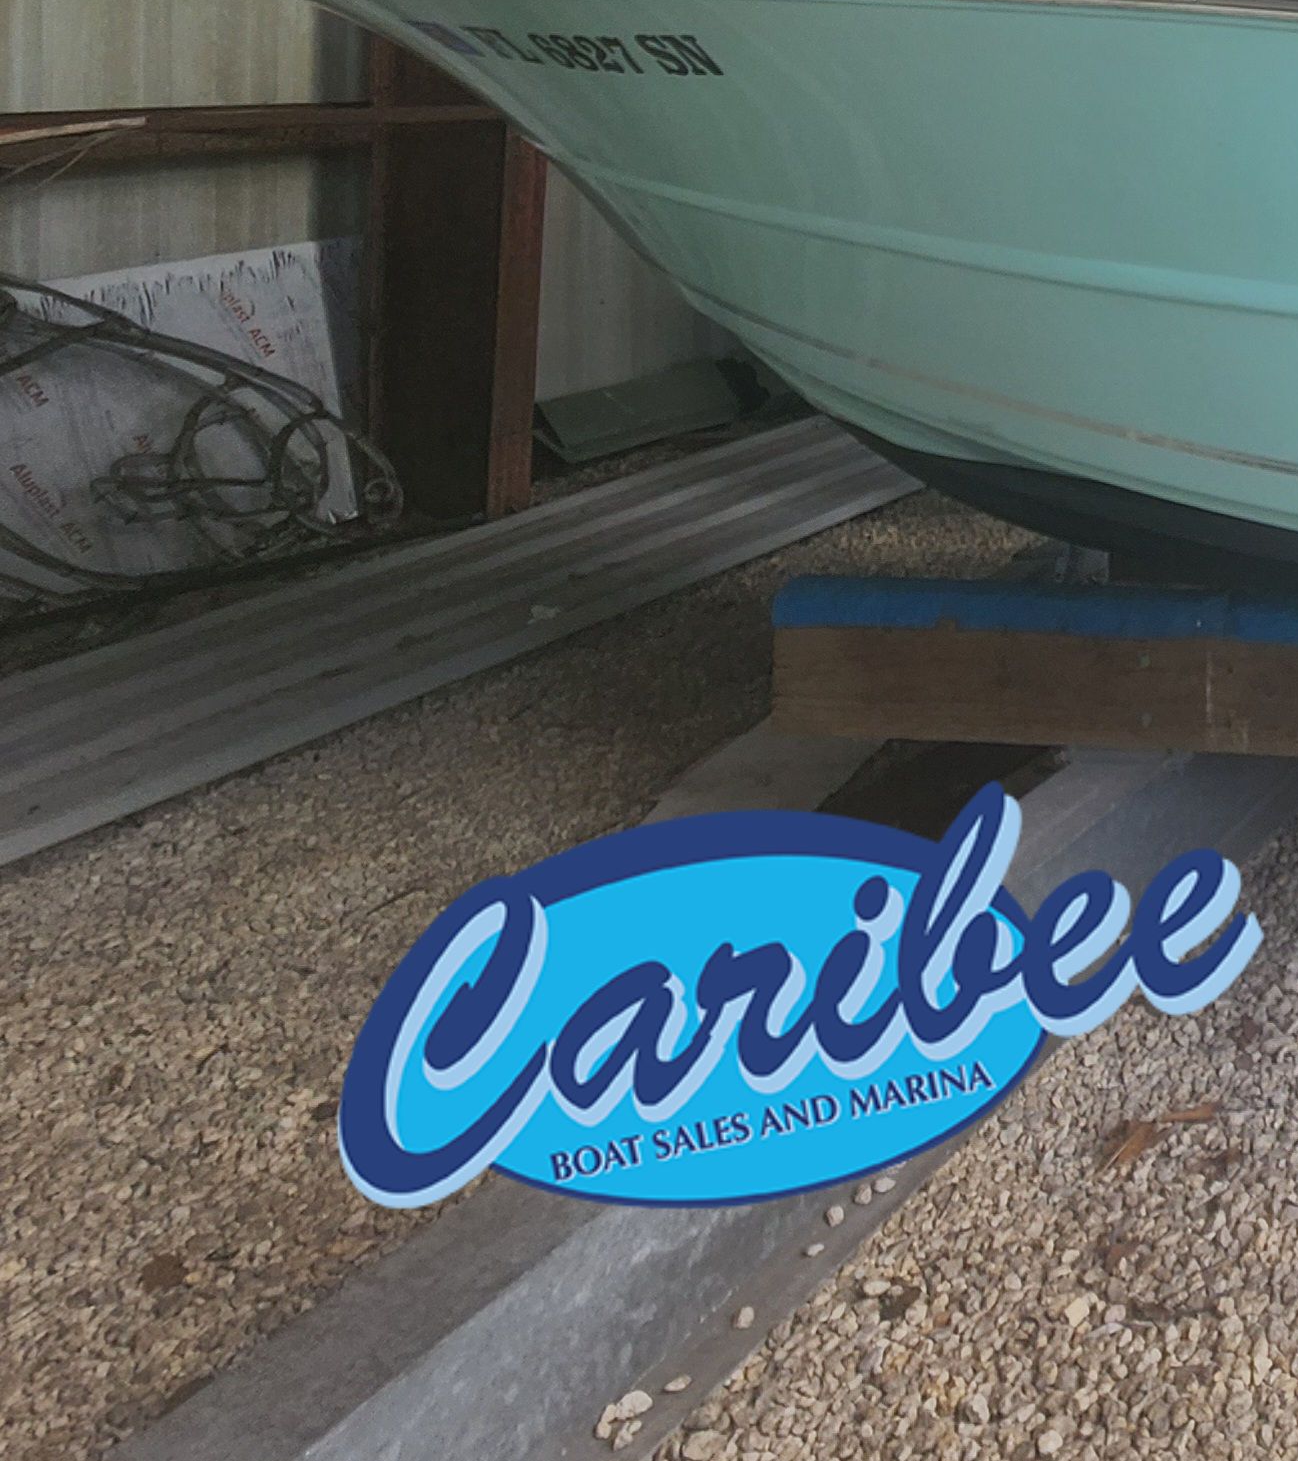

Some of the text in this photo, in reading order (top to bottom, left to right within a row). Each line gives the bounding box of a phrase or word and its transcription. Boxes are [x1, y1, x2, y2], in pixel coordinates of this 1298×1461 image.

[459, 25, 545, 65] FL
[634, 34, 724, 76] SN
[249, 327, 276, 358] ACM
[17, 374, 50, 408] ACM
[59, 521, 93, 554] ACM
